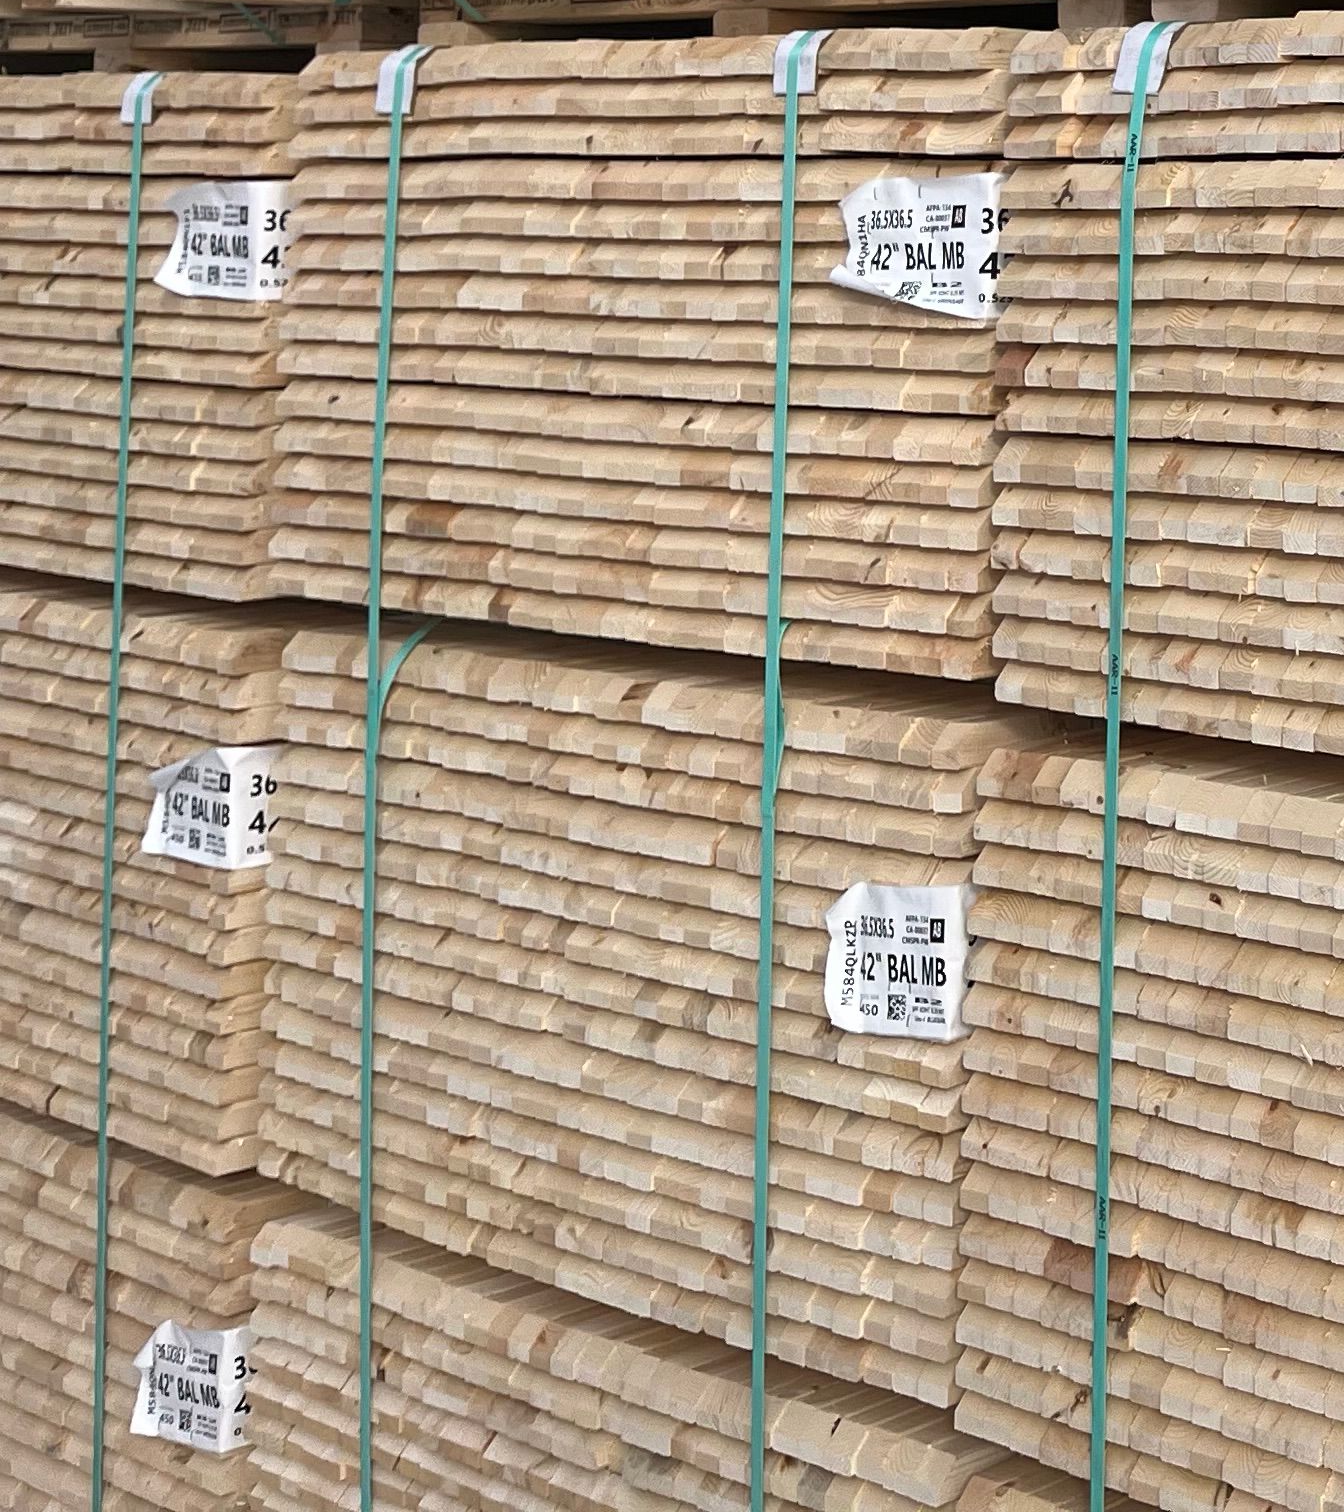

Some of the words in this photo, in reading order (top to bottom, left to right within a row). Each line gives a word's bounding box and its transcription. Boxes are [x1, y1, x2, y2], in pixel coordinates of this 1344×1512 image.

[871, 209, 913, 230] 36.5X36.5
[191, 233, 207, 256] 42"
[210, 234, 231, 257] BAL
[871, 242, 899, 271] 42"
[905, 242, 936, 270] BAL
[942, 242, 965, 270] MB
[172, 792, 189, 816] 42"
[191, 796, 210, 823] BAL
[212, 801, 230, 828] MB
[860, 915, 895, 939] 36.5X36.5
[860, 952, 882, 981] 42"
[888, 954, 917, 985] BAL
[921, 956, 947, 987] MB
[860, 1004, 879, 1016] 450
[158, 1372, 174, 1396] 42"
[177, 1377, 199, 1404] BAL
[200, 1383, 220, 1409] MB
